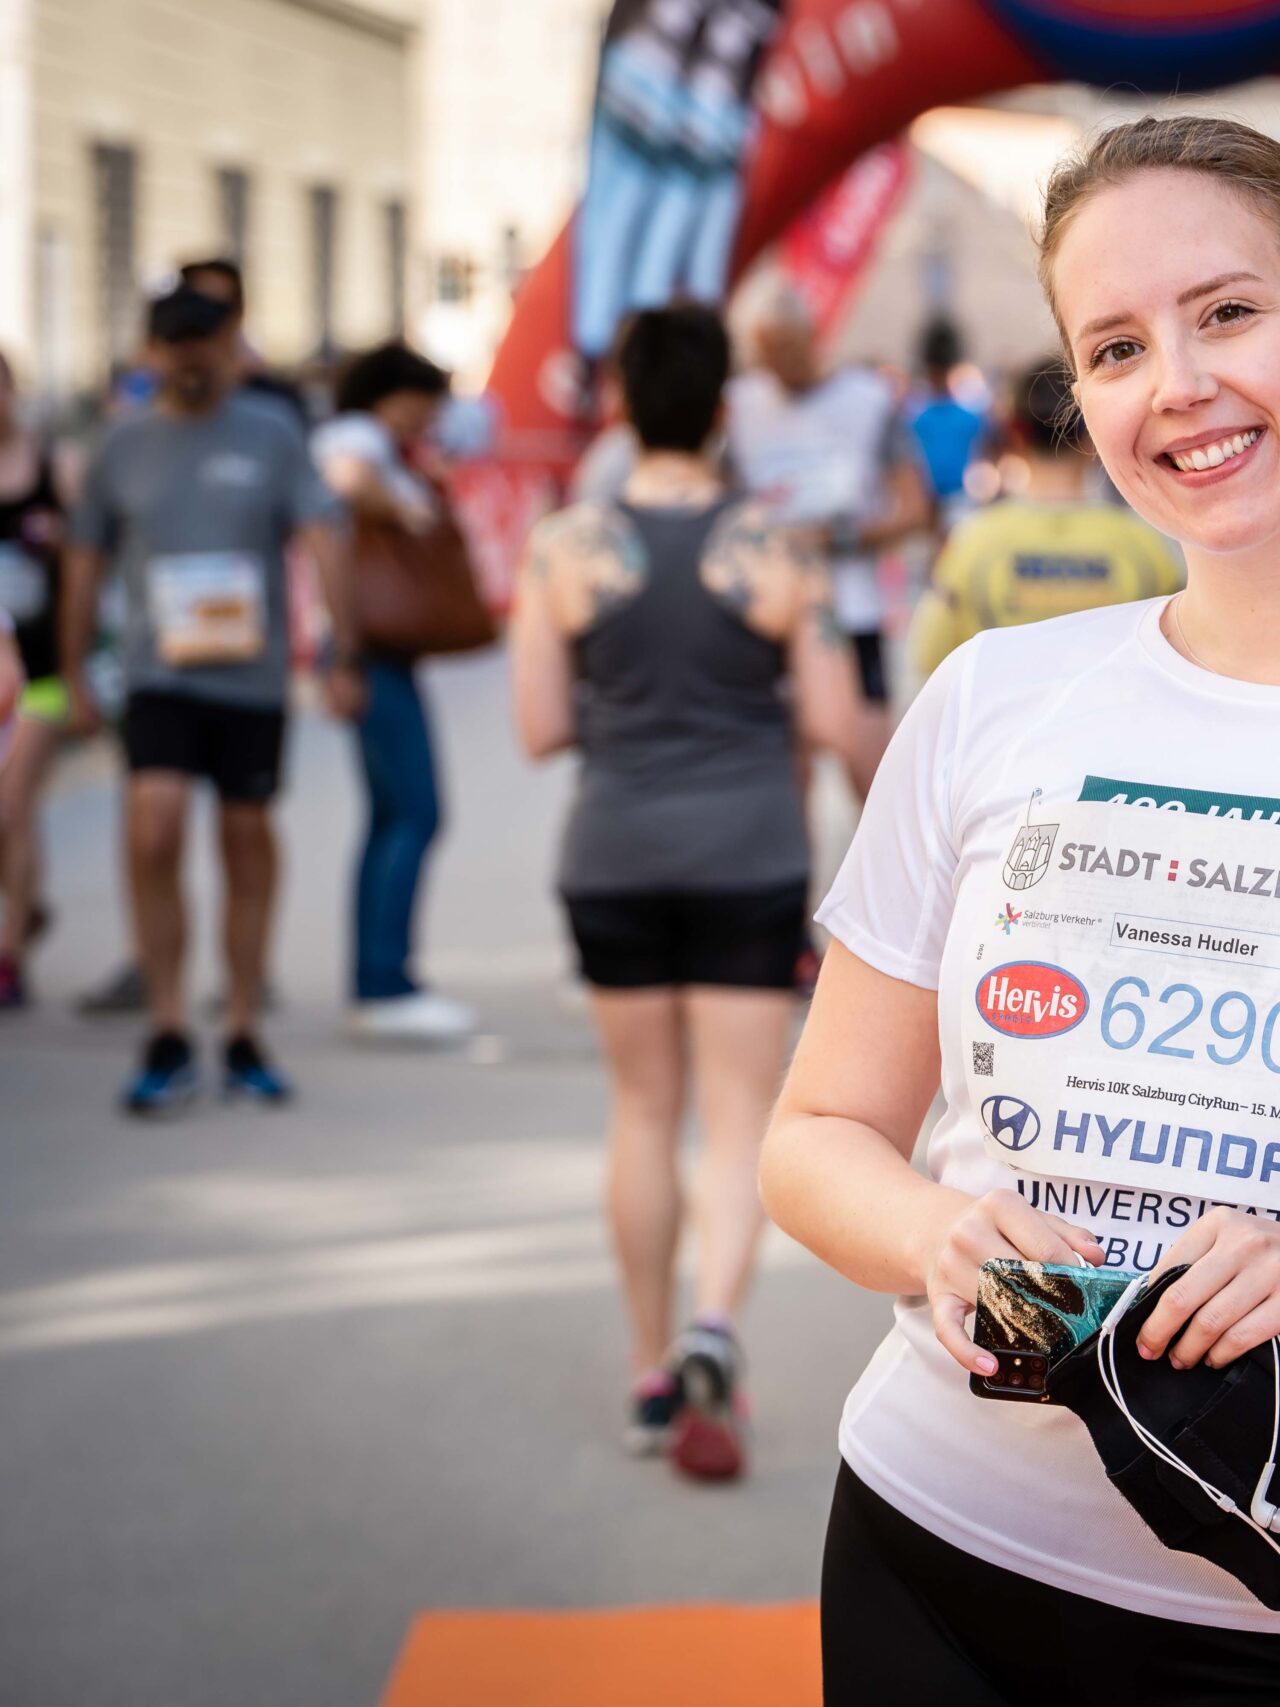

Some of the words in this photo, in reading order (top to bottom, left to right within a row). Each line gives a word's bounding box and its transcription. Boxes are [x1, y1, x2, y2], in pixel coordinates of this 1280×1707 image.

[1058, 842, 1161, 881] STADT
[1024, 910, 1060, 923] Salzburg
[1061, 914, 1097, 926] Verkehr
[1116, 922, 1191, 948] Vanessa
[1198, 934, 1259, 957] Hudler
[987, 975, 1078, 1023] Hervis
[1066, 1076, 1105, 1091] Hervis
[1107, 1081, 1129, 1095] 10K
[1131, 1085, 1186, 1105] Salzburg
[1251, 1103, 1267, 1117] 15.
